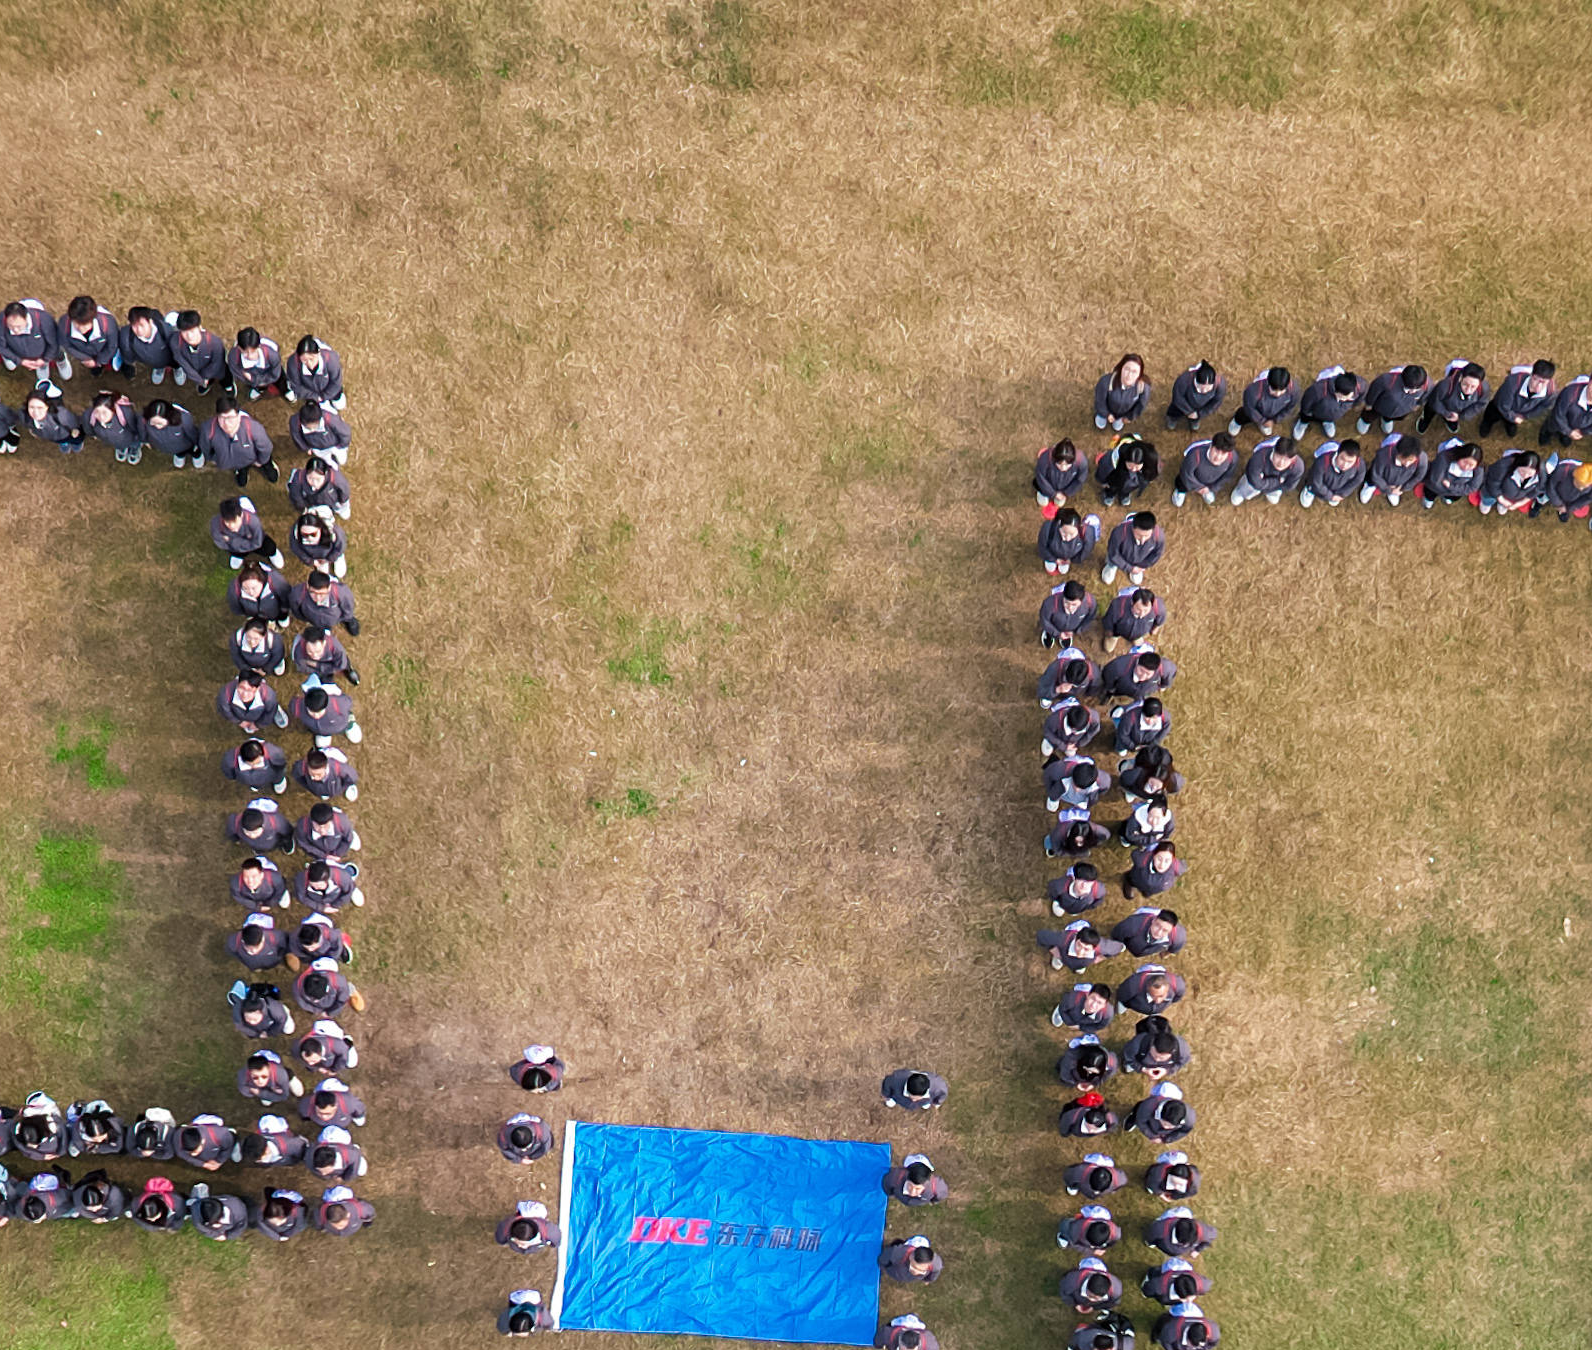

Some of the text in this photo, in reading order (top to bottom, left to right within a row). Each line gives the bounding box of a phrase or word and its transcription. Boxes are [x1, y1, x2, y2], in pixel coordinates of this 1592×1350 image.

[629, 1216, 822, 1252] DKE 东方科脉
